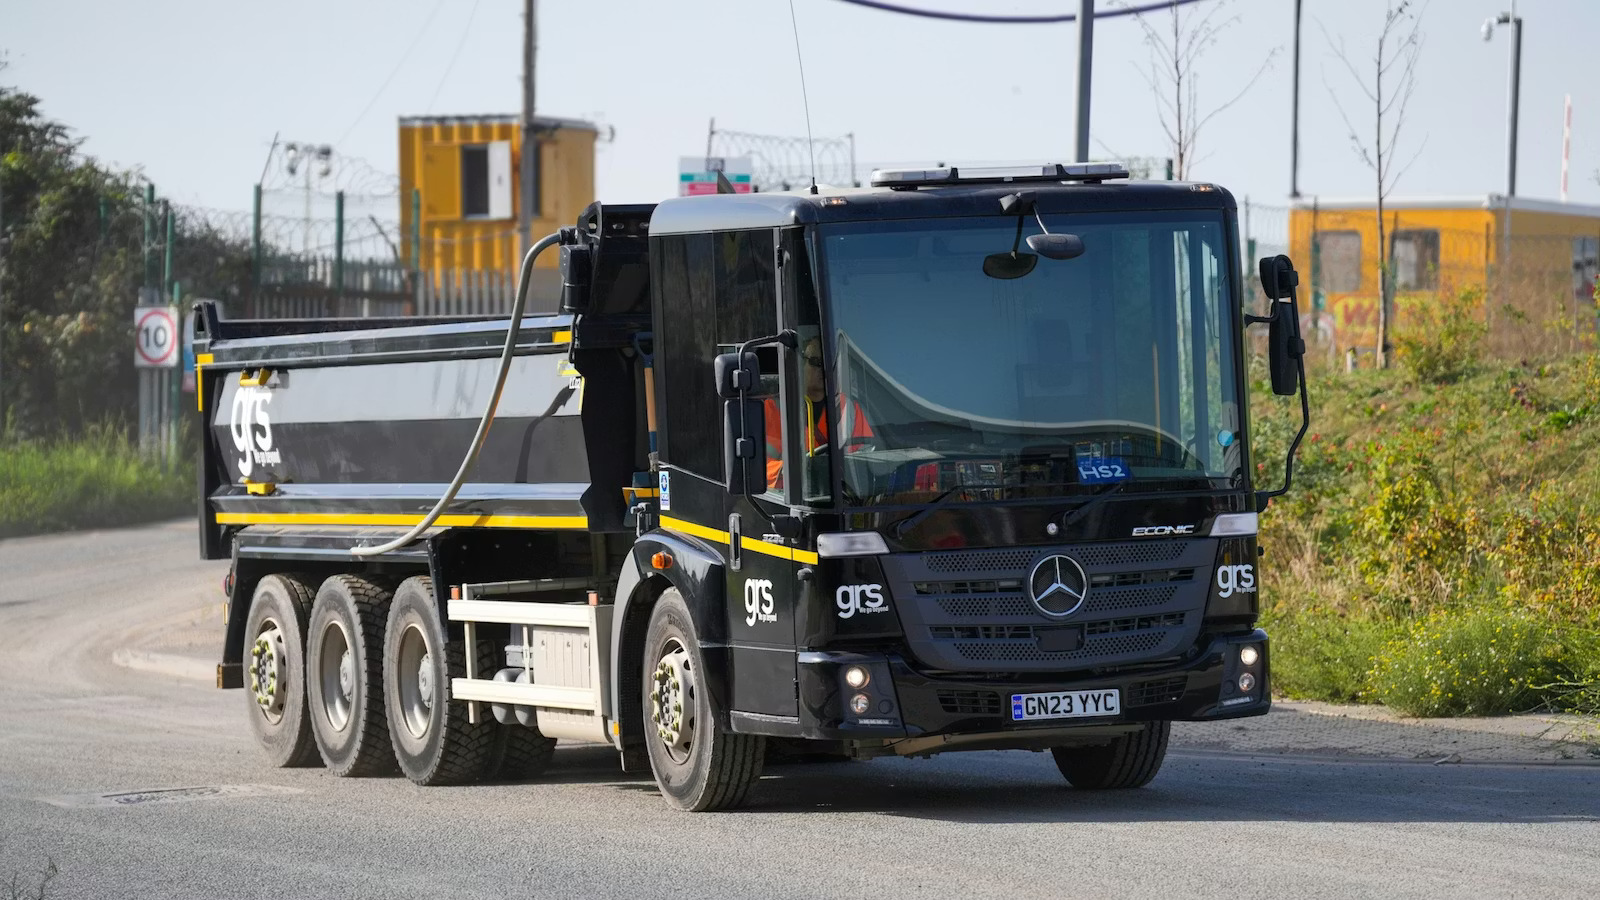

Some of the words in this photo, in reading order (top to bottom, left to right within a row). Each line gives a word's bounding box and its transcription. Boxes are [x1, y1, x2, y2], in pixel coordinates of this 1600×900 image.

[143, 326, 167, 348] 10
[231, 386, 272, 476] grs
[1078, 465, 1126, 479] HS2
[1131, 525, 1195, 537] ECONIC
[1217, 564, 1254, 598] grs
[744, 578, 774, 627] grs
[836, 583, 884, 619] grs
[1025, 695, 1073, 715] GN23
[1079, 692, 1115, 713] YYC
